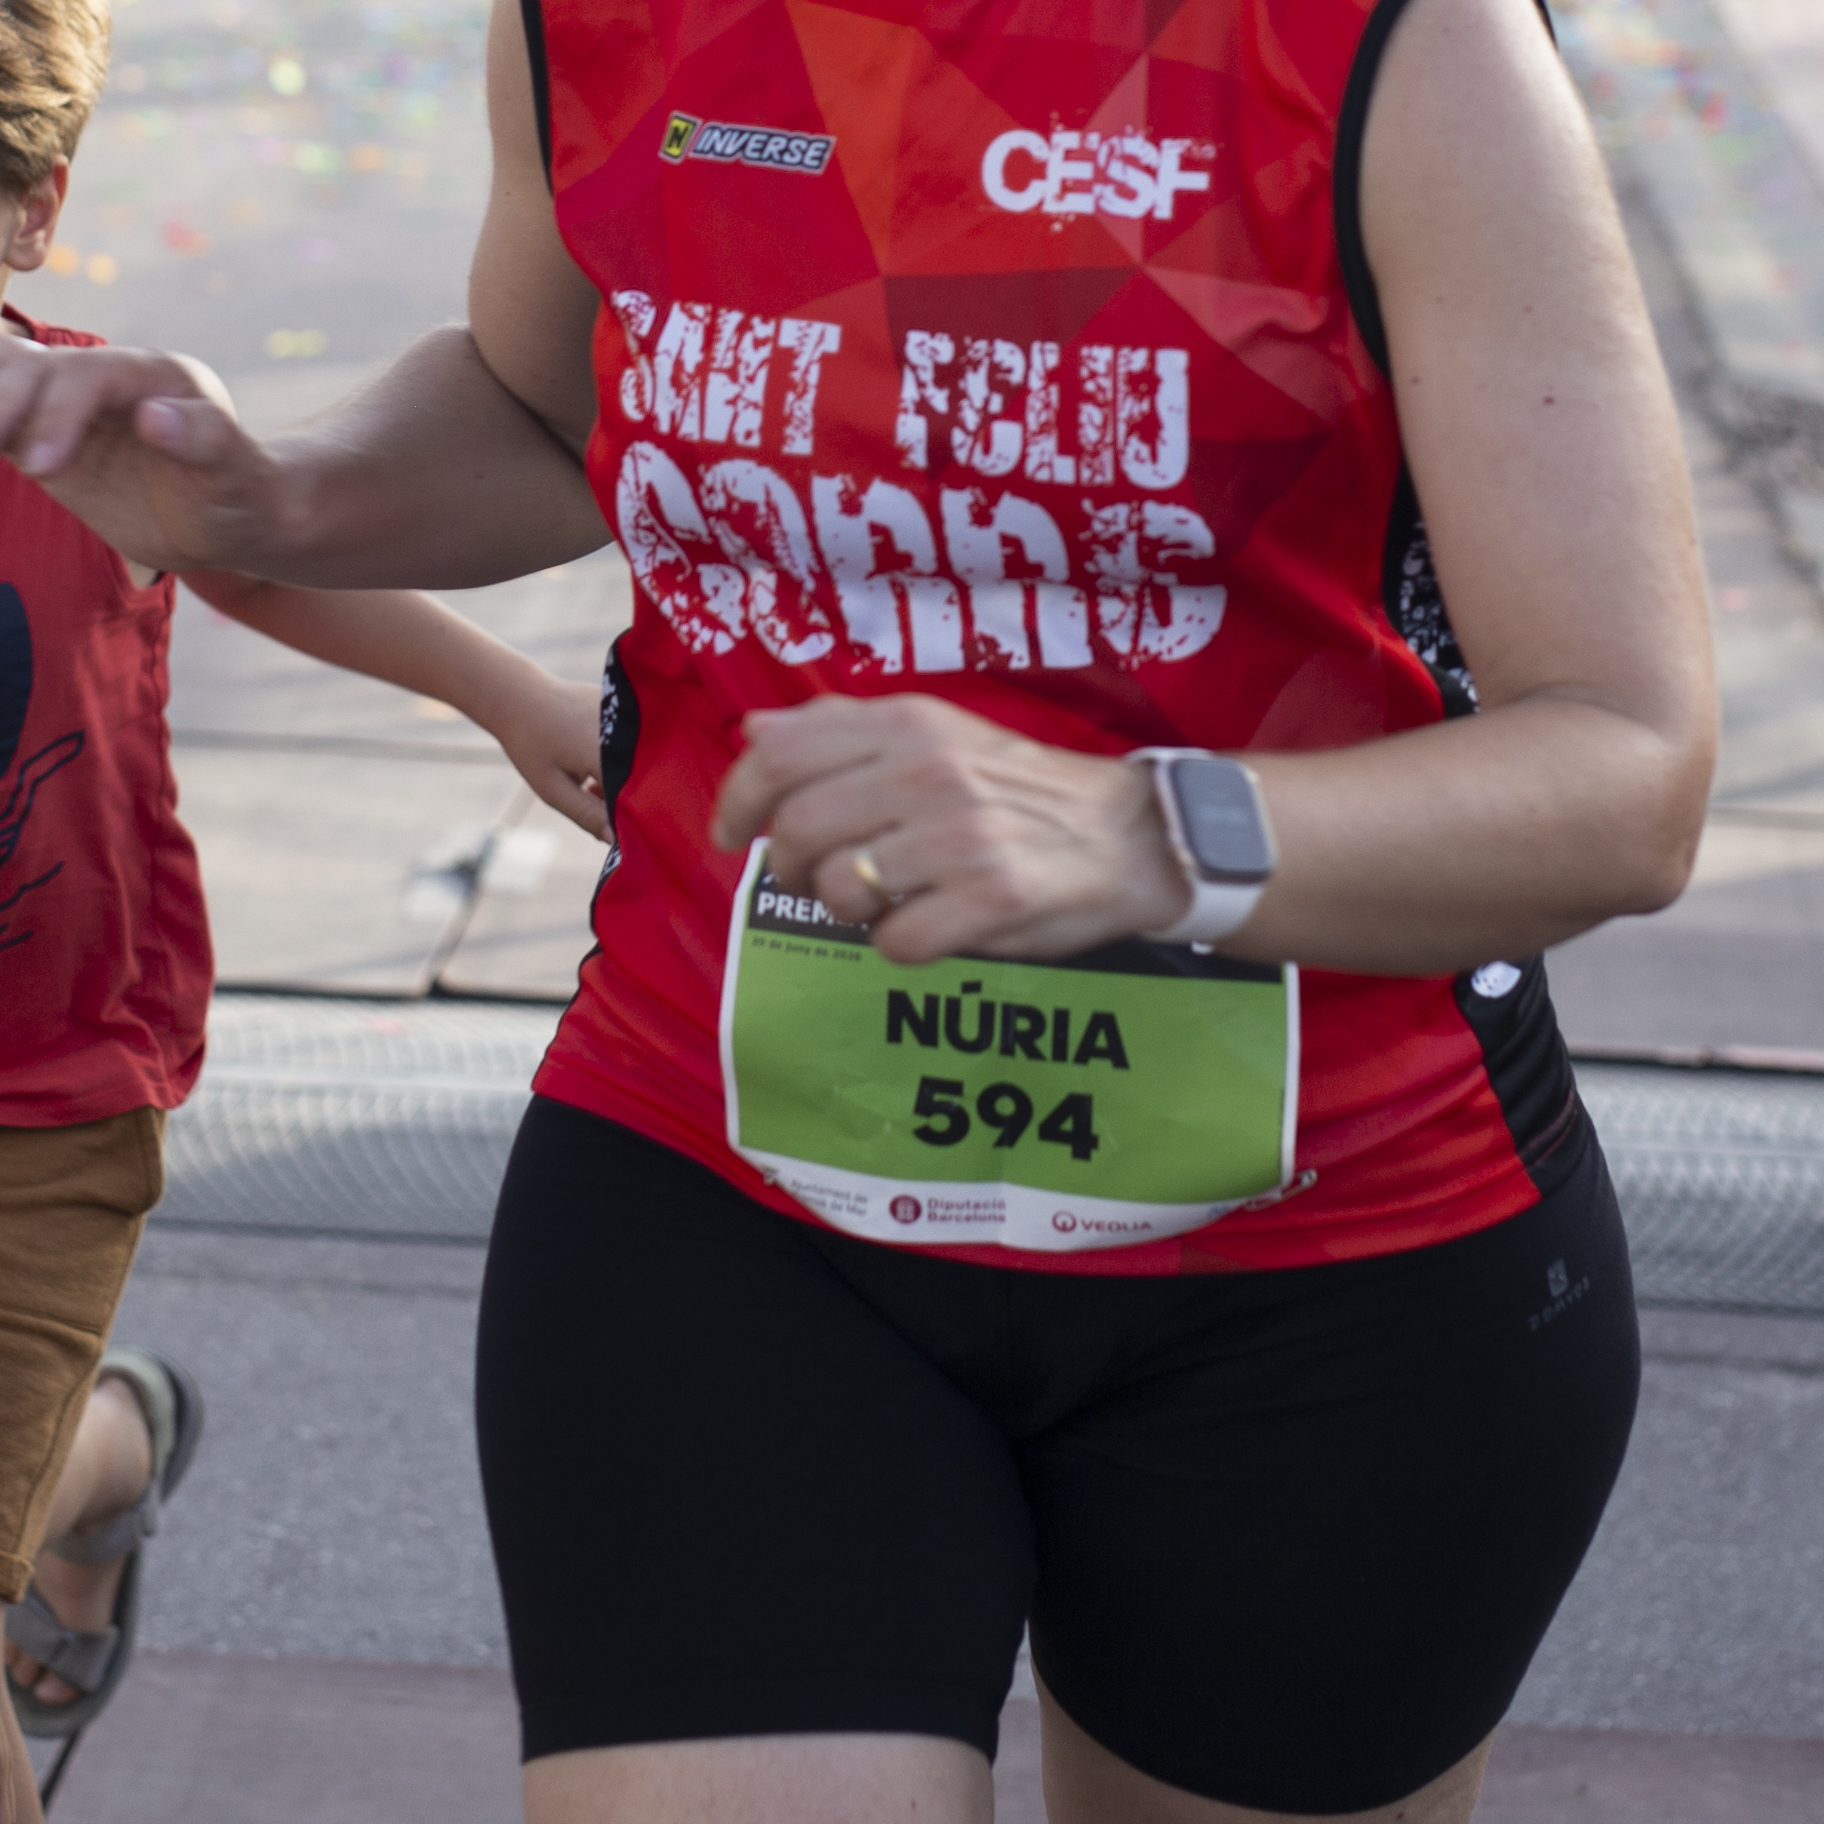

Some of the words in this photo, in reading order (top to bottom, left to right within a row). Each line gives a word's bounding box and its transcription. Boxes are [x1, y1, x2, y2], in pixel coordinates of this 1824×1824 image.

[694, 126, 827, 168] INVERSE
[980, 127, 1212, 220] CESF
[895, 328, 1190, 491] FELIU
[885, 979, 1131, 1071] NÚRIA
[912, 1075, 1099, 1162] 594
[927, 1196, 1006, 1212] Diputació
[927, 1210, 1006, 1223] Barcelona
[1080, 1219, 1152, 1233] VEOLIA
